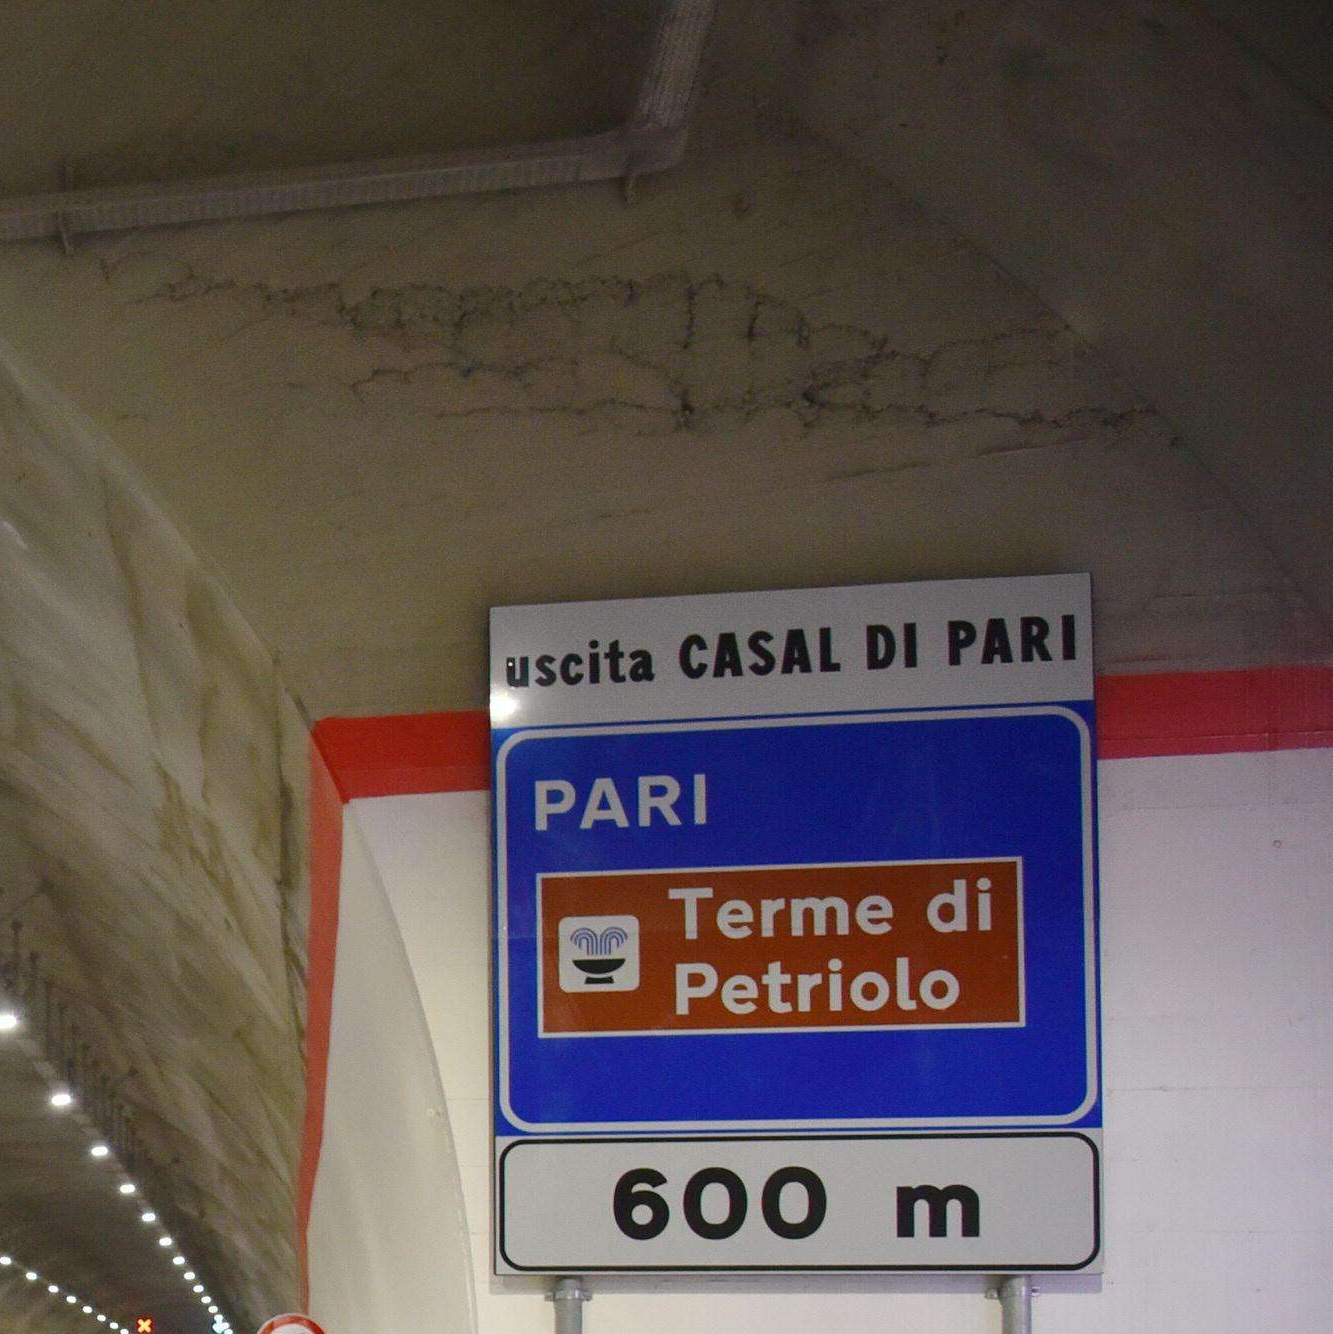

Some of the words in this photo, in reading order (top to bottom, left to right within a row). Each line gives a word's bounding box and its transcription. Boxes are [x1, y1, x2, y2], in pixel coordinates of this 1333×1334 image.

[505, 638, 656, 688] uscita
[678, 625, 842, 680] CASAL
[865, 621, 919, 671] DI
[946, 613, 1077, 667] PARI
[535, 774, 708, 831] PARI
[668, 887, 894, 940] Terme
[926, 878, 992, 934] di
[675, 957, 961, 1015] Petriolo
[613, 1166, 828, 1241] 600
[896, 1183, 981, 1238] m
